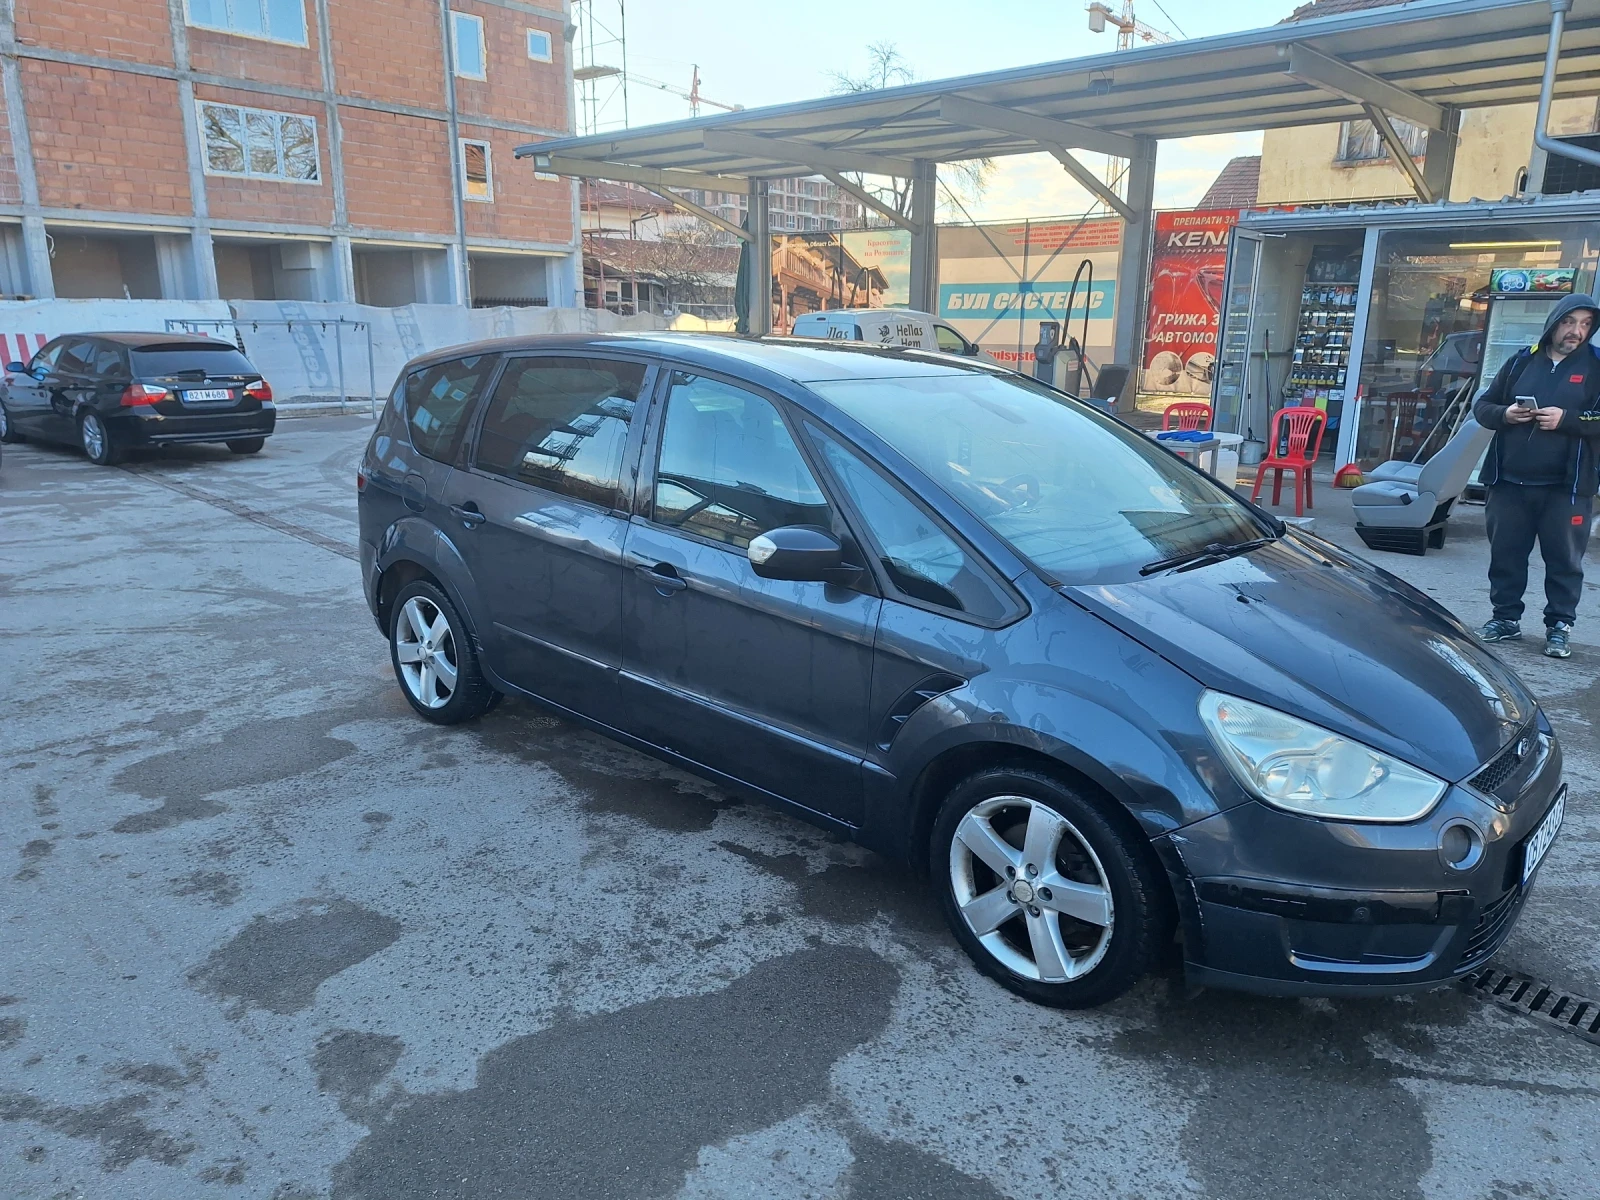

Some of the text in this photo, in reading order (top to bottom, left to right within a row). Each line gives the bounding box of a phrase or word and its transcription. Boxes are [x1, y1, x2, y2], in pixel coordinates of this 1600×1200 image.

[1174, 215, 1235, 226] ПРЕПАРАТИ ЗА
[1167, 231, 1228, 247] KEN
[947, 290, 1105, 310] БУЛ СИСТЕМС
[1157, 313, 1220, 326] ГРИЖА З
[896, 323, 923, 337] Hellas
[986, 350, 1037, 362] ulsyste
